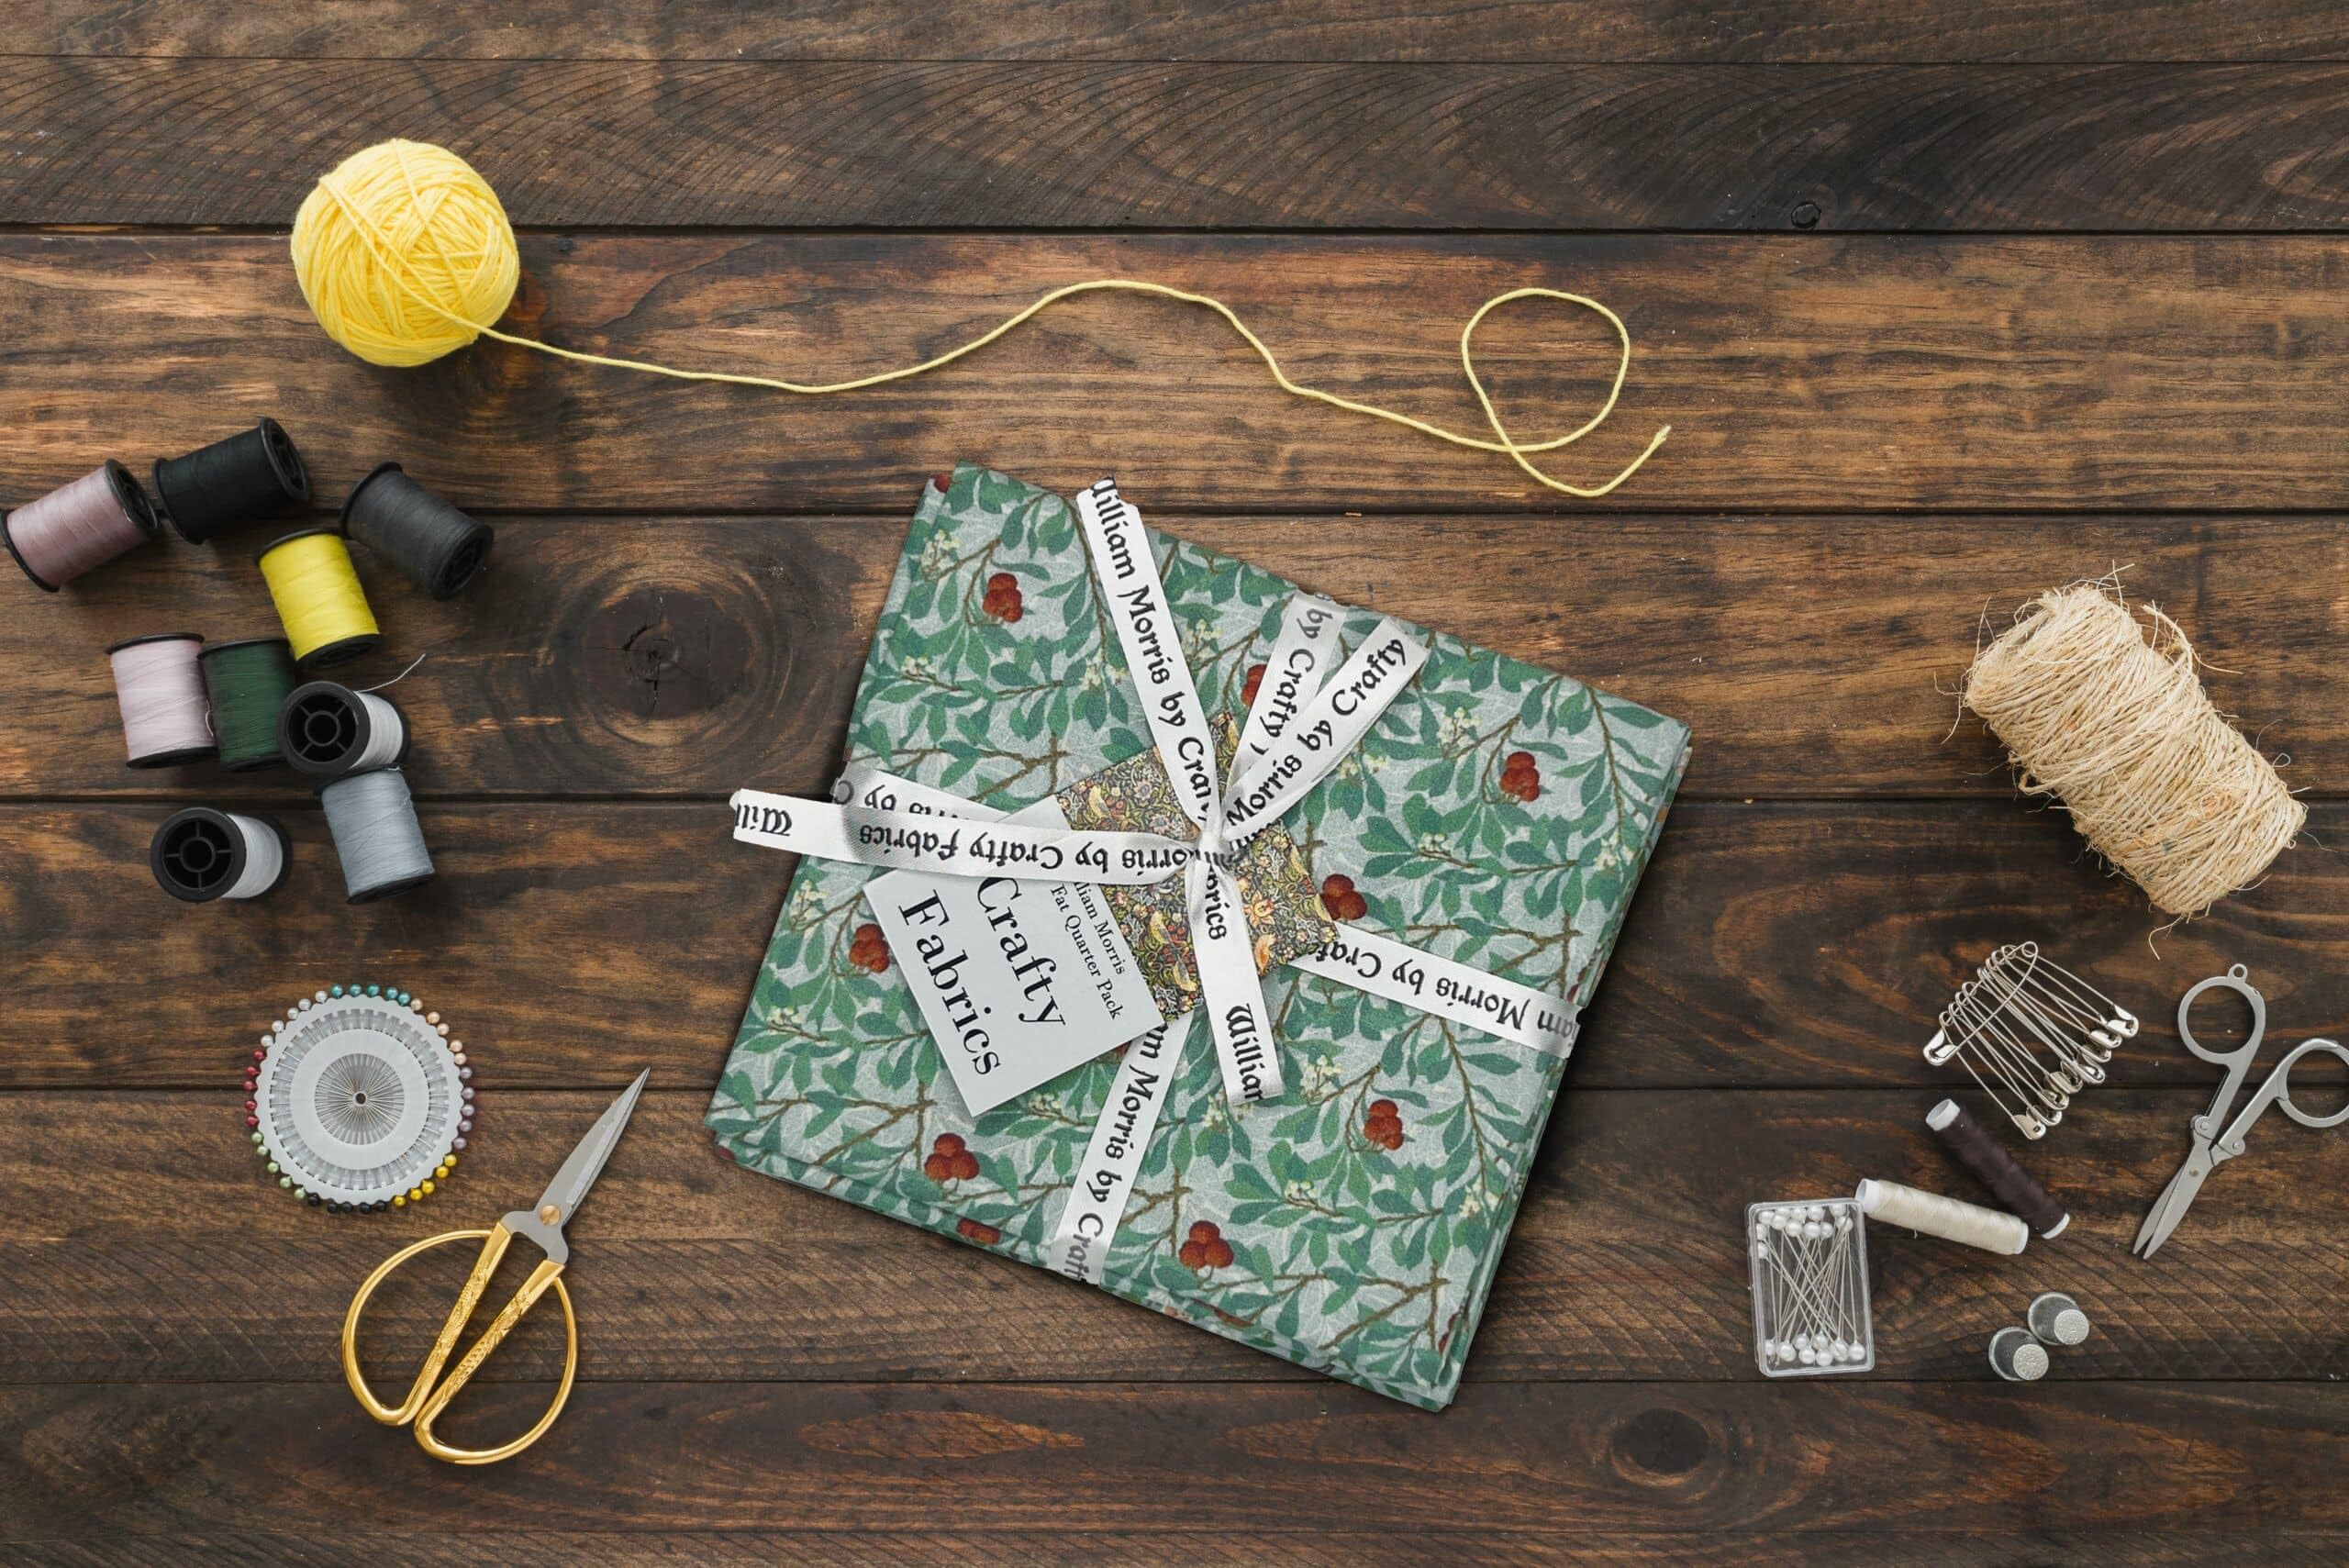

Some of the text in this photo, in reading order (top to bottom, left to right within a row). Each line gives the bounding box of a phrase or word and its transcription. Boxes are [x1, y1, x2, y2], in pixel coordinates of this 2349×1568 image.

[1297, 608, 1333, 639] by
[1117, 584, 1174, 684] Morris
[1158, 691, 1186, 728] by
[1260, 649, 1315, 738] Crafty
[1226, 755, 1303, 826] Morris
[1297, 719, 1333, 751] by
[1331, 639, 1406, 716] Crafty
[970, 832, 1063, 869] Crafty
[1075, 841, 1108, 873] by
[1122, 848, 1197, 876] orris
[976, 877, 1066, 1026] Crafty
[1051, 884, 1124, 1020] Fat Quarter Pack
[1094, 919, 1126, 974] Morris
[898, 888, 1001, 1075] Fabrics
[1392, 959, 1425, 995] by
[1435, 977, 1531, 1030] Morris
[1105, 1064, 1159, 1161] Morris
[1086, 1169, 1122, 1204] by
